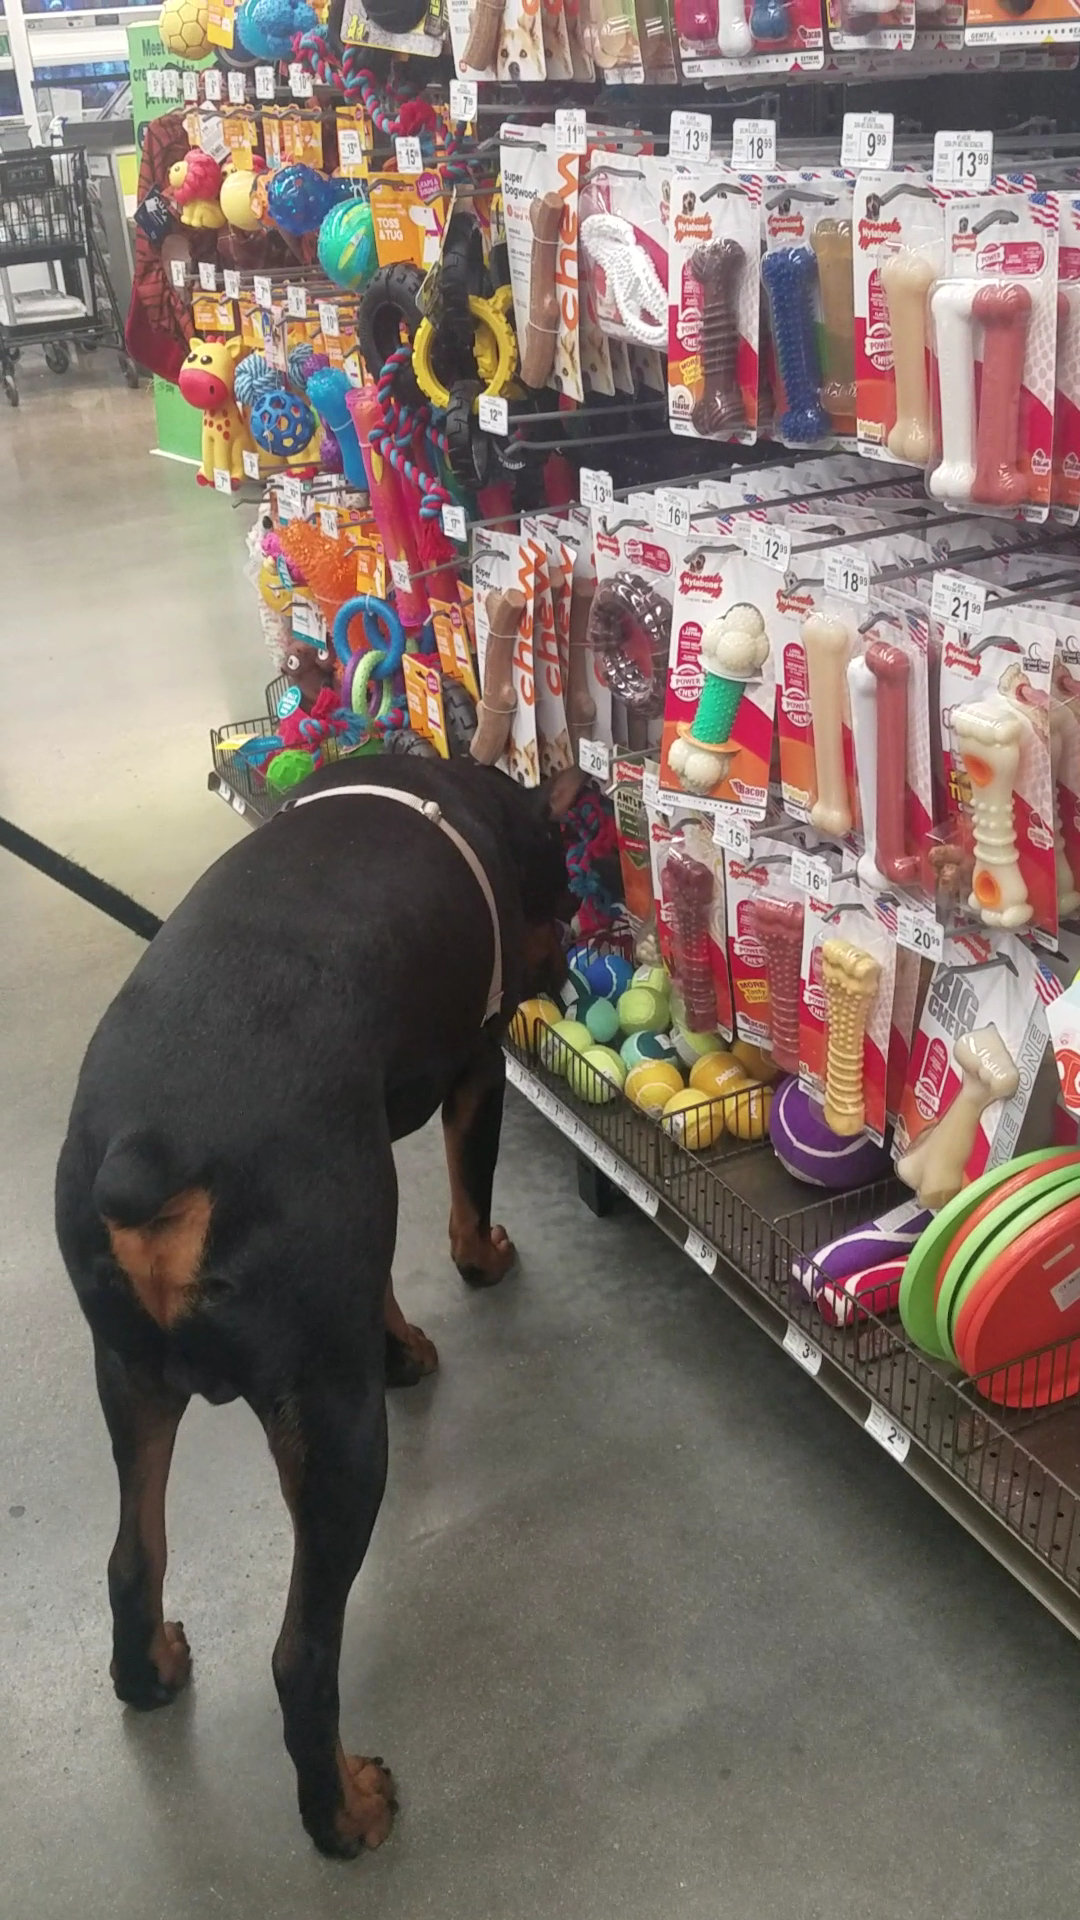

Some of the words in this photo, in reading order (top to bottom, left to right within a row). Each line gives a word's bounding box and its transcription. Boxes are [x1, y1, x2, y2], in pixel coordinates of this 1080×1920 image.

[504, 169, 523, 185] Super
[504, 181, 538, 200] Dogwood
[377, 217, 400, 229] TOSS
[683, 576, 719, 590] Nylabone
[675, 677, 701, 687] POWER
[739, 785, 766, 798] Bacon
[738, 981, 766, 989] MORE
[934, 973, 980, 1033] BIG
